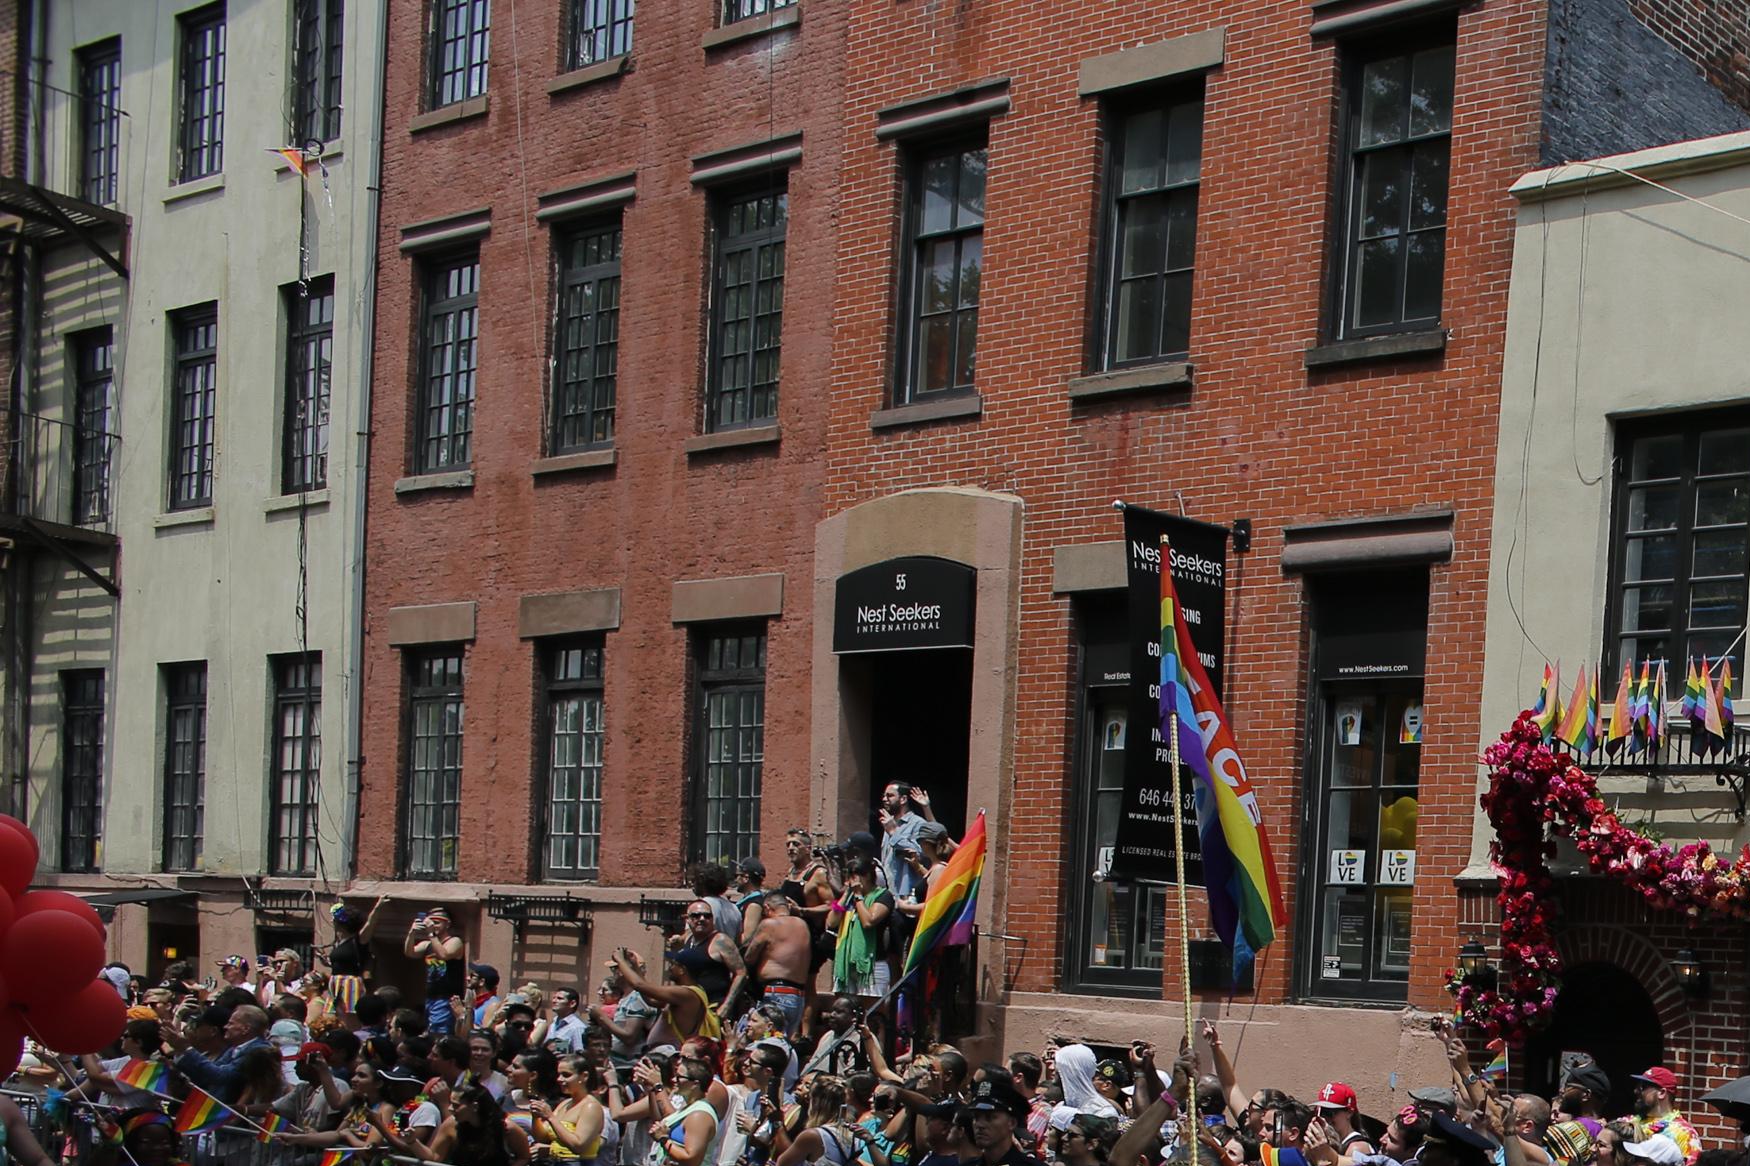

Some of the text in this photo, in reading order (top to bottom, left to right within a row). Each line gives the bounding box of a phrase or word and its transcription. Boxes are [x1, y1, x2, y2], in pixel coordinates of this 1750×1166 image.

[1133, 541, 1222, 577] Nes Seekers
[895, 574, 906, 590] 55
[1134, 561, 1222, 588] INTENATIONAL
[858, 602, 941, 623] Nest Seekers
[857, 622, 940, 634] INTERNATIONAL
[1339, 664, 1408, 673] www.NestSeekers.com
[1139, 788, 1160, 806] 646
[1122, 846, 1152, 857] LICENSED
